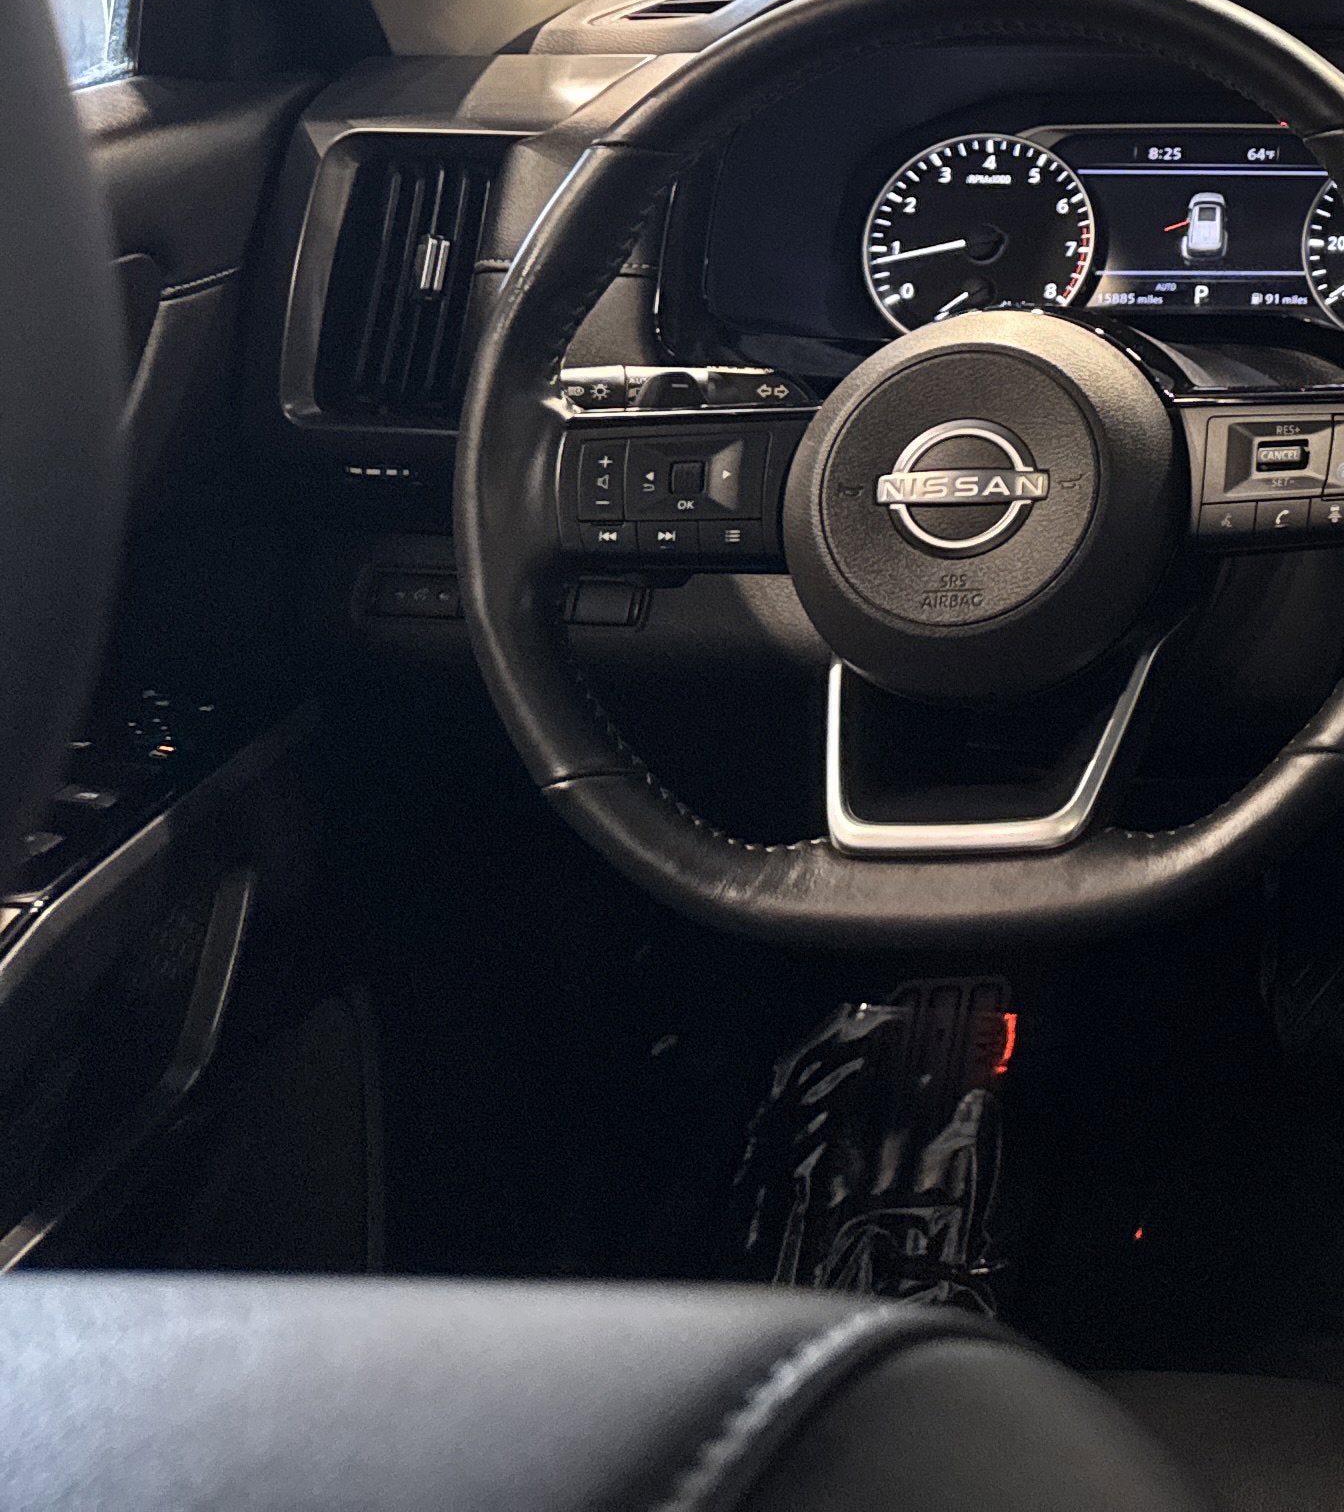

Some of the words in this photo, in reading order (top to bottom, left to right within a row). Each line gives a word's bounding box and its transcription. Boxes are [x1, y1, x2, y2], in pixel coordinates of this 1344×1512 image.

[1148, 147, 1182, 160] 8:25
[982, 155, 996, 170] 4
[938, 166, 952, 183] 3
[1028, 167, 1041, 184] 5
[903, 197, 917, 213] 2
[1056, 198, 1069, 214] 6
[891, 241, 900, 255] 1
[1065, 241, 1078, 256] 7
[900, 283, 914, 299] 0
[1044, 283, 1057, 299] 8
[1194, 285, 1209, 306] P
[1137, 294, 1163, 305] miles
[1265, 294, 1280, 305] 91
[1282, 294, 1308, 305] miles
[1276, 425, 1300, 435] RES+
[1260, 450, 1298, 461] CANCEL
[881, 476, 1044, 500] NISSAN
[677, 500, 695, 510] OK
[940, 574, 968, 588] SRS
[921, 593, 984, 609] AIRBAG
